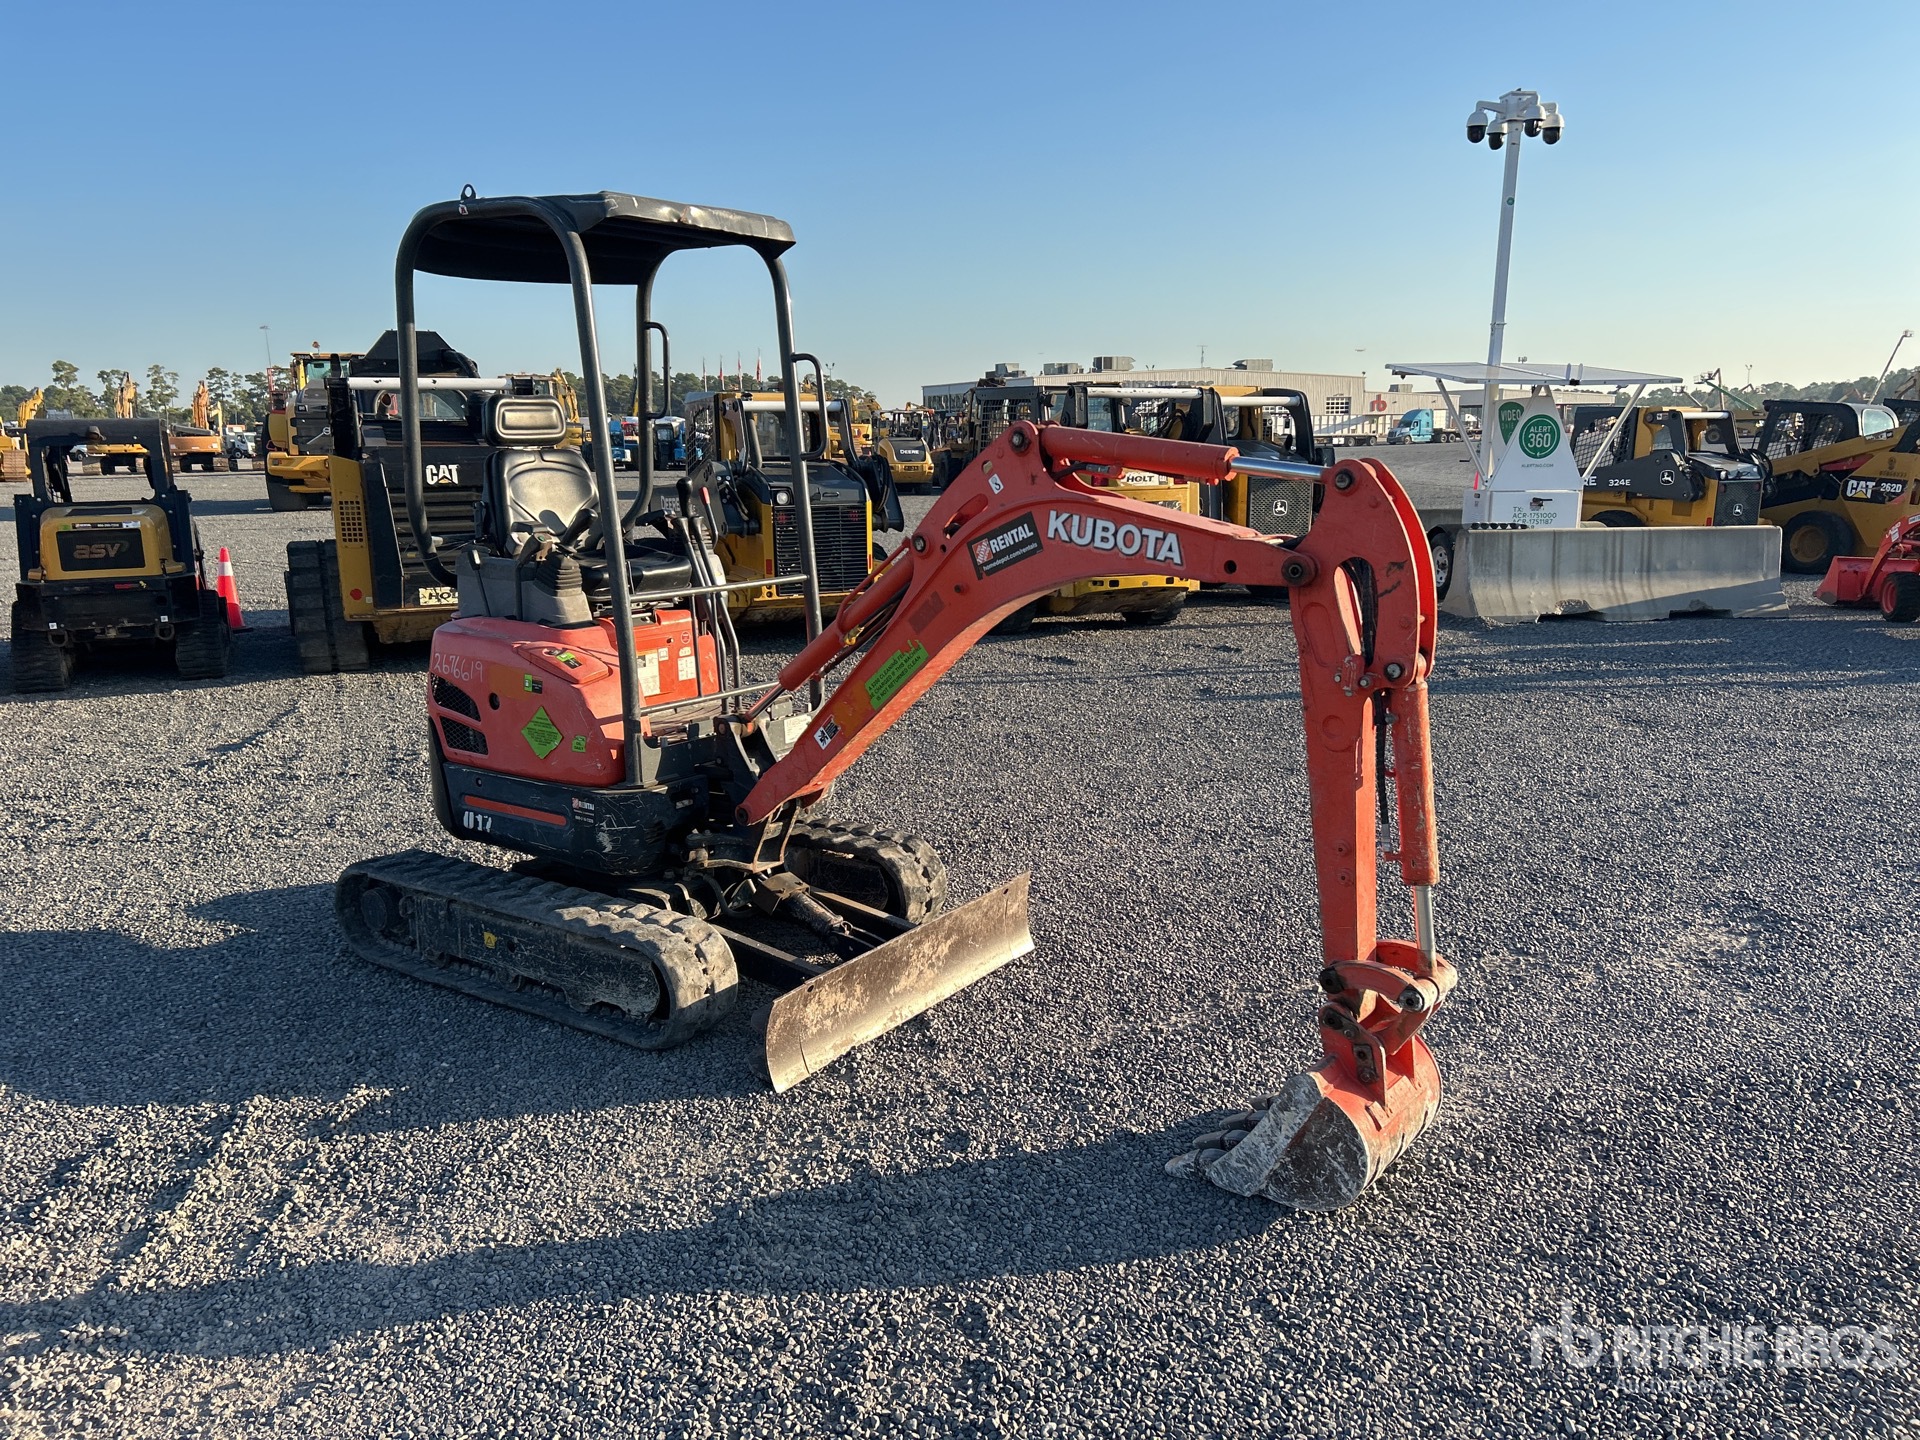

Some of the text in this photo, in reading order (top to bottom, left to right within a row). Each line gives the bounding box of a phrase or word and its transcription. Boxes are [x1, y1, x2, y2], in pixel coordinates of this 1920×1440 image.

[1501, 409, 1521, 421] VIDEO
[1528, 433, 1551, 448] 360
[426, 464, 459, 485] CAT
[1608, 479, 1631, 487] 324E
[1846, 480, 1902, 498] CAT 262D
[990, 523, 1034, 554] RENTAL
[1047, 510, 1183, 565] KUBOTA
[434, 653, 483, 683] 2676619
